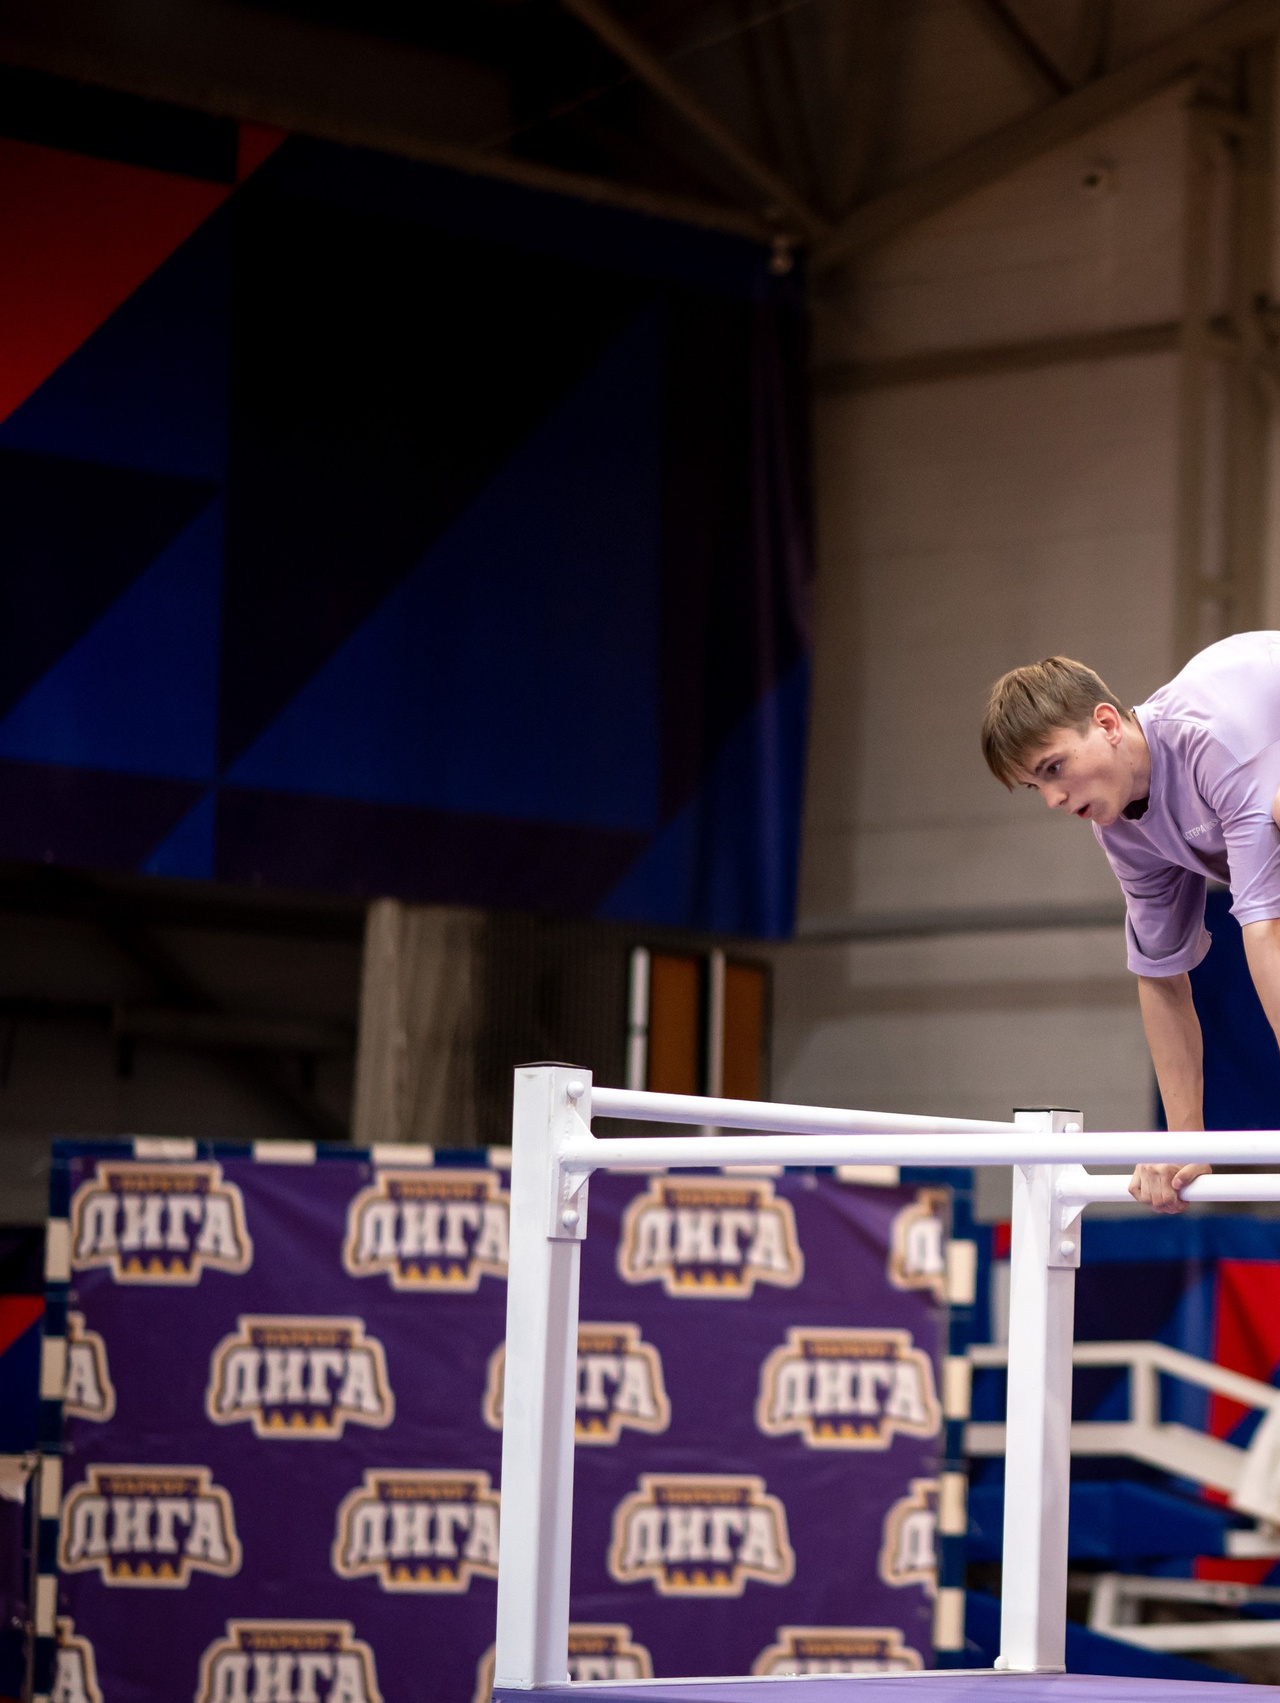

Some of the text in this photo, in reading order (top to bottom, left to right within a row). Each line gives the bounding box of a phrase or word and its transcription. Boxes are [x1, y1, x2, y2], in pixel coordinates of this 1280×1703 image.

[79, 1194, 239, 1258] ЛИГА
[358, 1203, 510, 1262] ЛИГА
[632, 1210, 789, 1271] ЛИГА
[220, 1349, 381, 1412] ЛИГА
[577, 1356, 656, 1417] ГА
[772, 1361, 927, 1422] ЛИГА
[67, 1498, 228, 1561] ЛИГА
[346, 1503, 499, 1565] ЛИГА
[623, 1508, 780, 1569] ЛИГА
